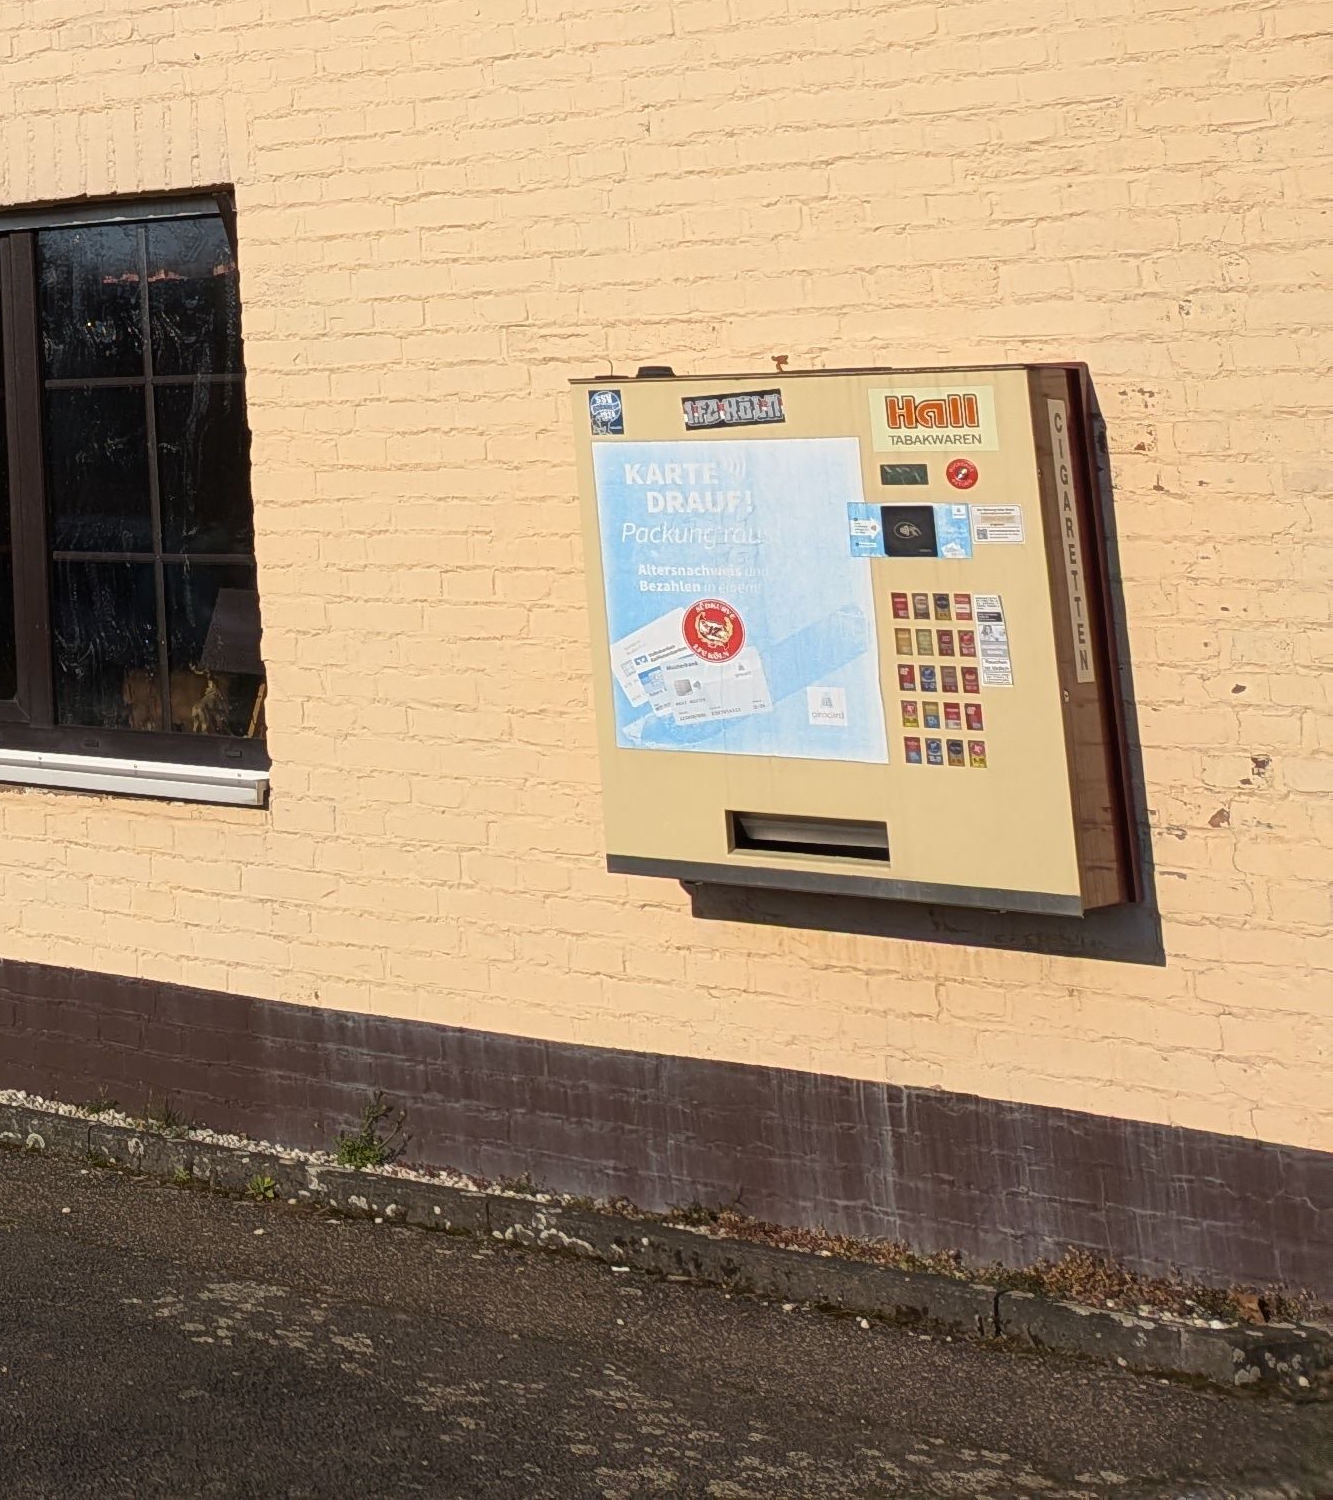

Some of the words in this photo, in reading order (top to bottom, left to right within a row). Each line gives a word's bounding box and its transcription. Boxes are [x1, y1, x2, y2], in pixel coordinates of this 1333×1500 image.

[885, 394, 980, 430] Hall
[888, 434, 982, 446] TABAKWAREN
[624, 463, 719, 484] KARTE
[646, 491, 753, 513] DRAUF!
[621, 522, 717, 549] Packung
[1053, 412, 1089, 671] CIGARETTEN
[638, 565, 741, 577] Altersnachweis
[639, 581, 701, 592] Bezahlen
